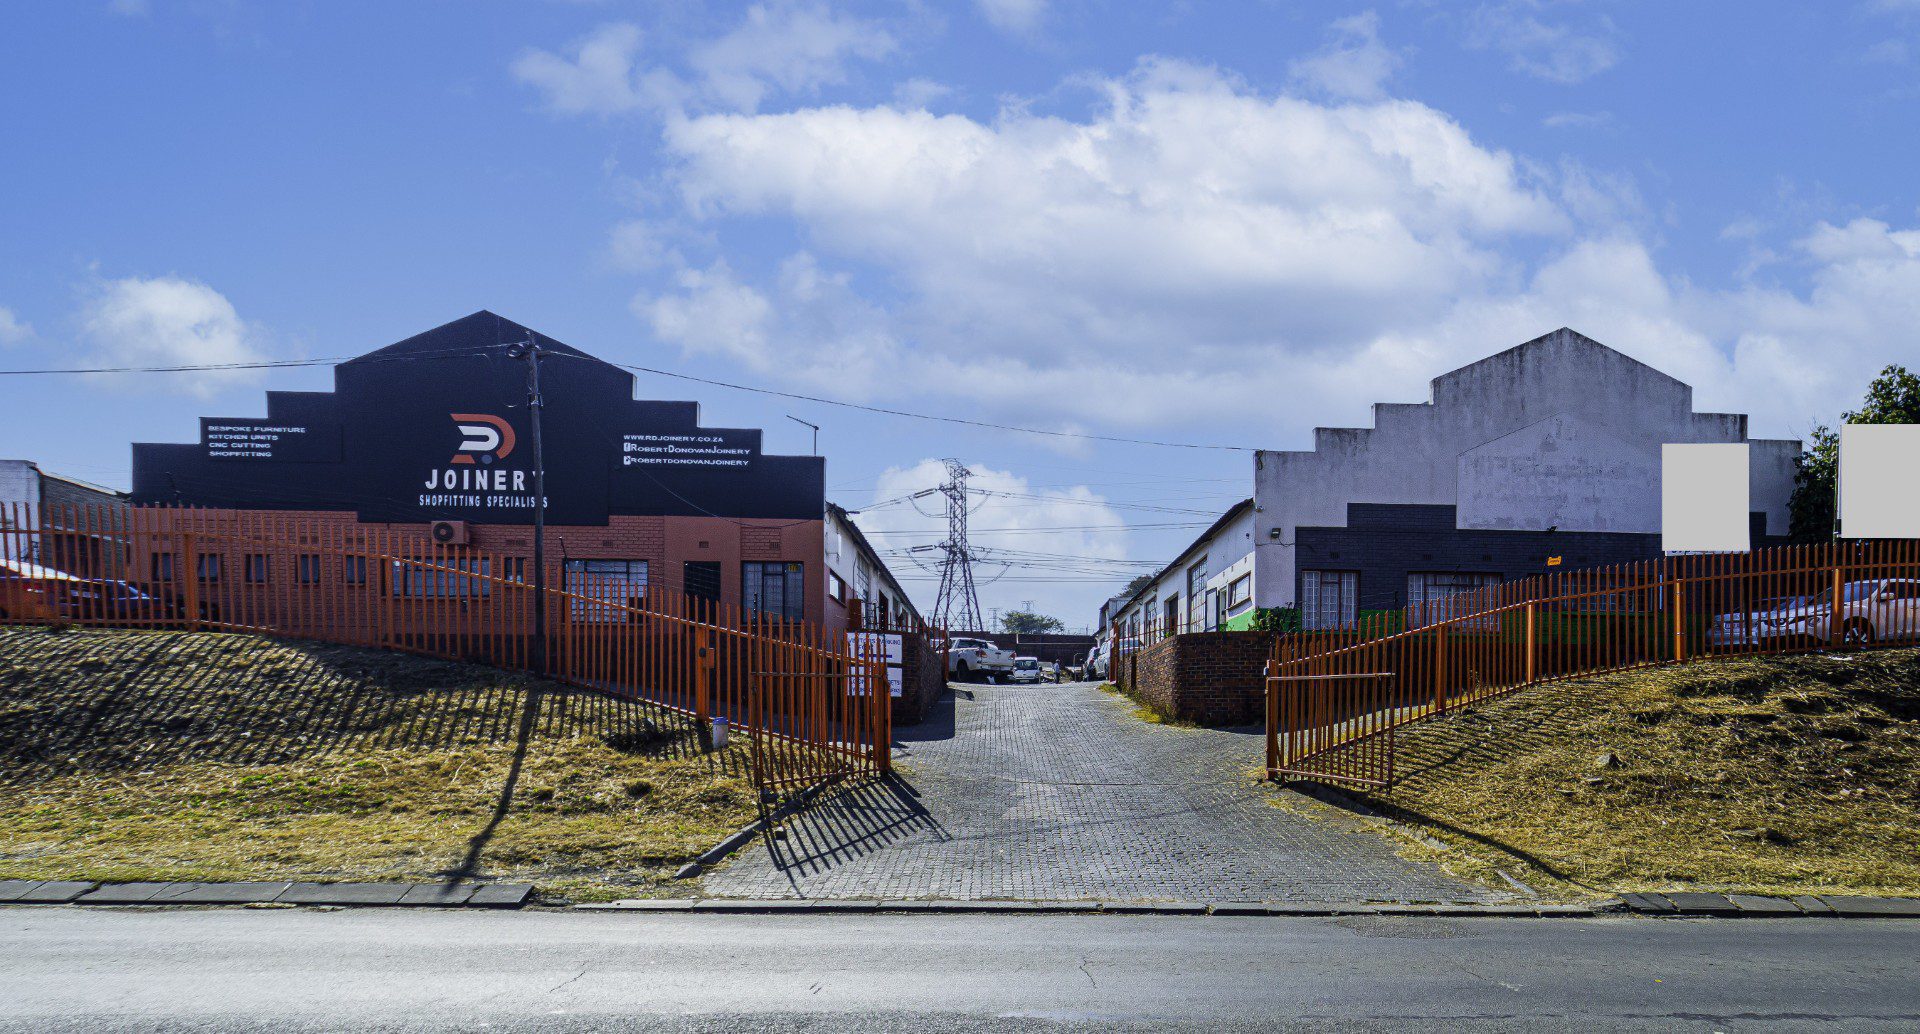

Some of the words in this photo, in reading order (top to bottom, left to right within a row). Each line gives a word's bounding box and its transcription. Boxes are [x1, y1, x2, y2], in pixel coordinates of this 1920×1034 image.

[631, 457, 749, 466] ROBERTDONOVANJOINERY
[419, 494, 480, 507] SHOPFITTING
[486, 495, 548, 508] SPECIALISS
